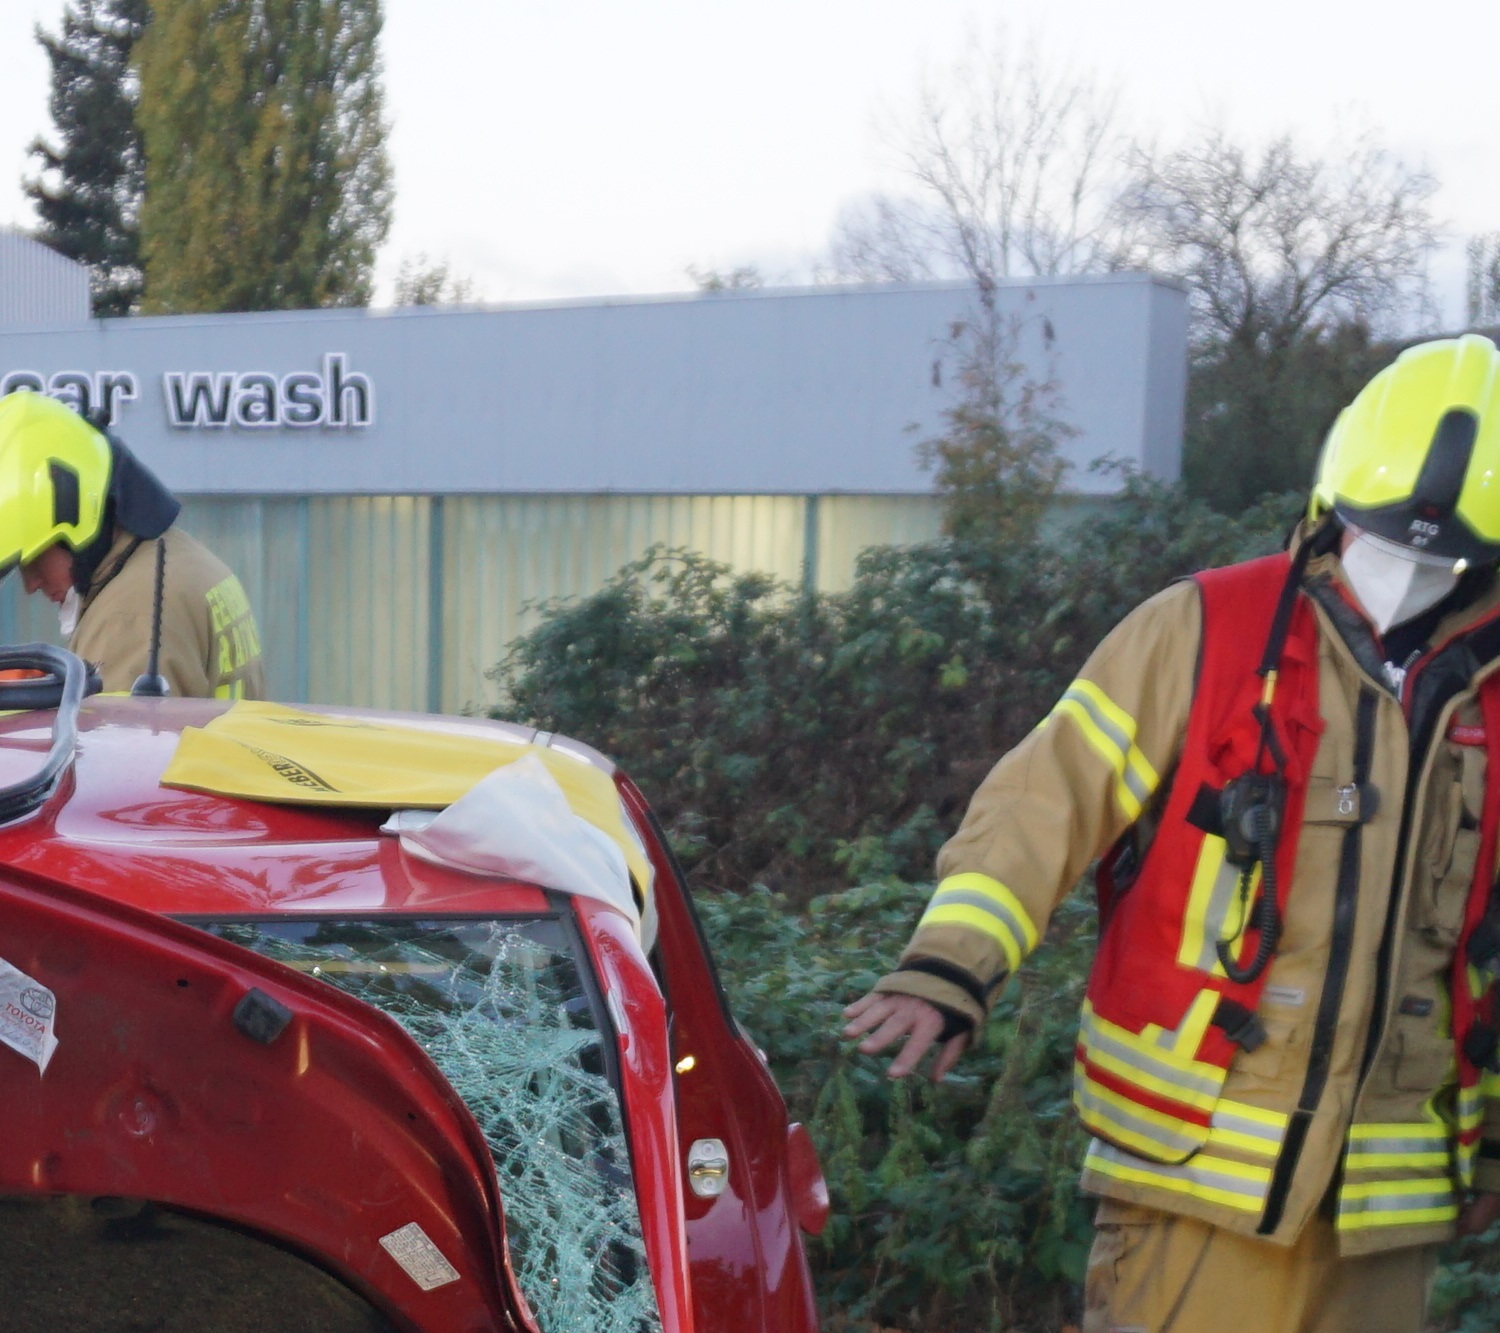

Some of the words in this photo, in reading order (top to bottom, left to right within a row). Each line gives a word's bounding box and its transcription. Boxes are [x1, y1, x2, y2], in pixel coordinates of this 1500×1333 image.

[164, 352, 373, 428] wash
[1408, 519, 1439, 536] RTG
[5, 1002, 46, 1035] TOYOTA
